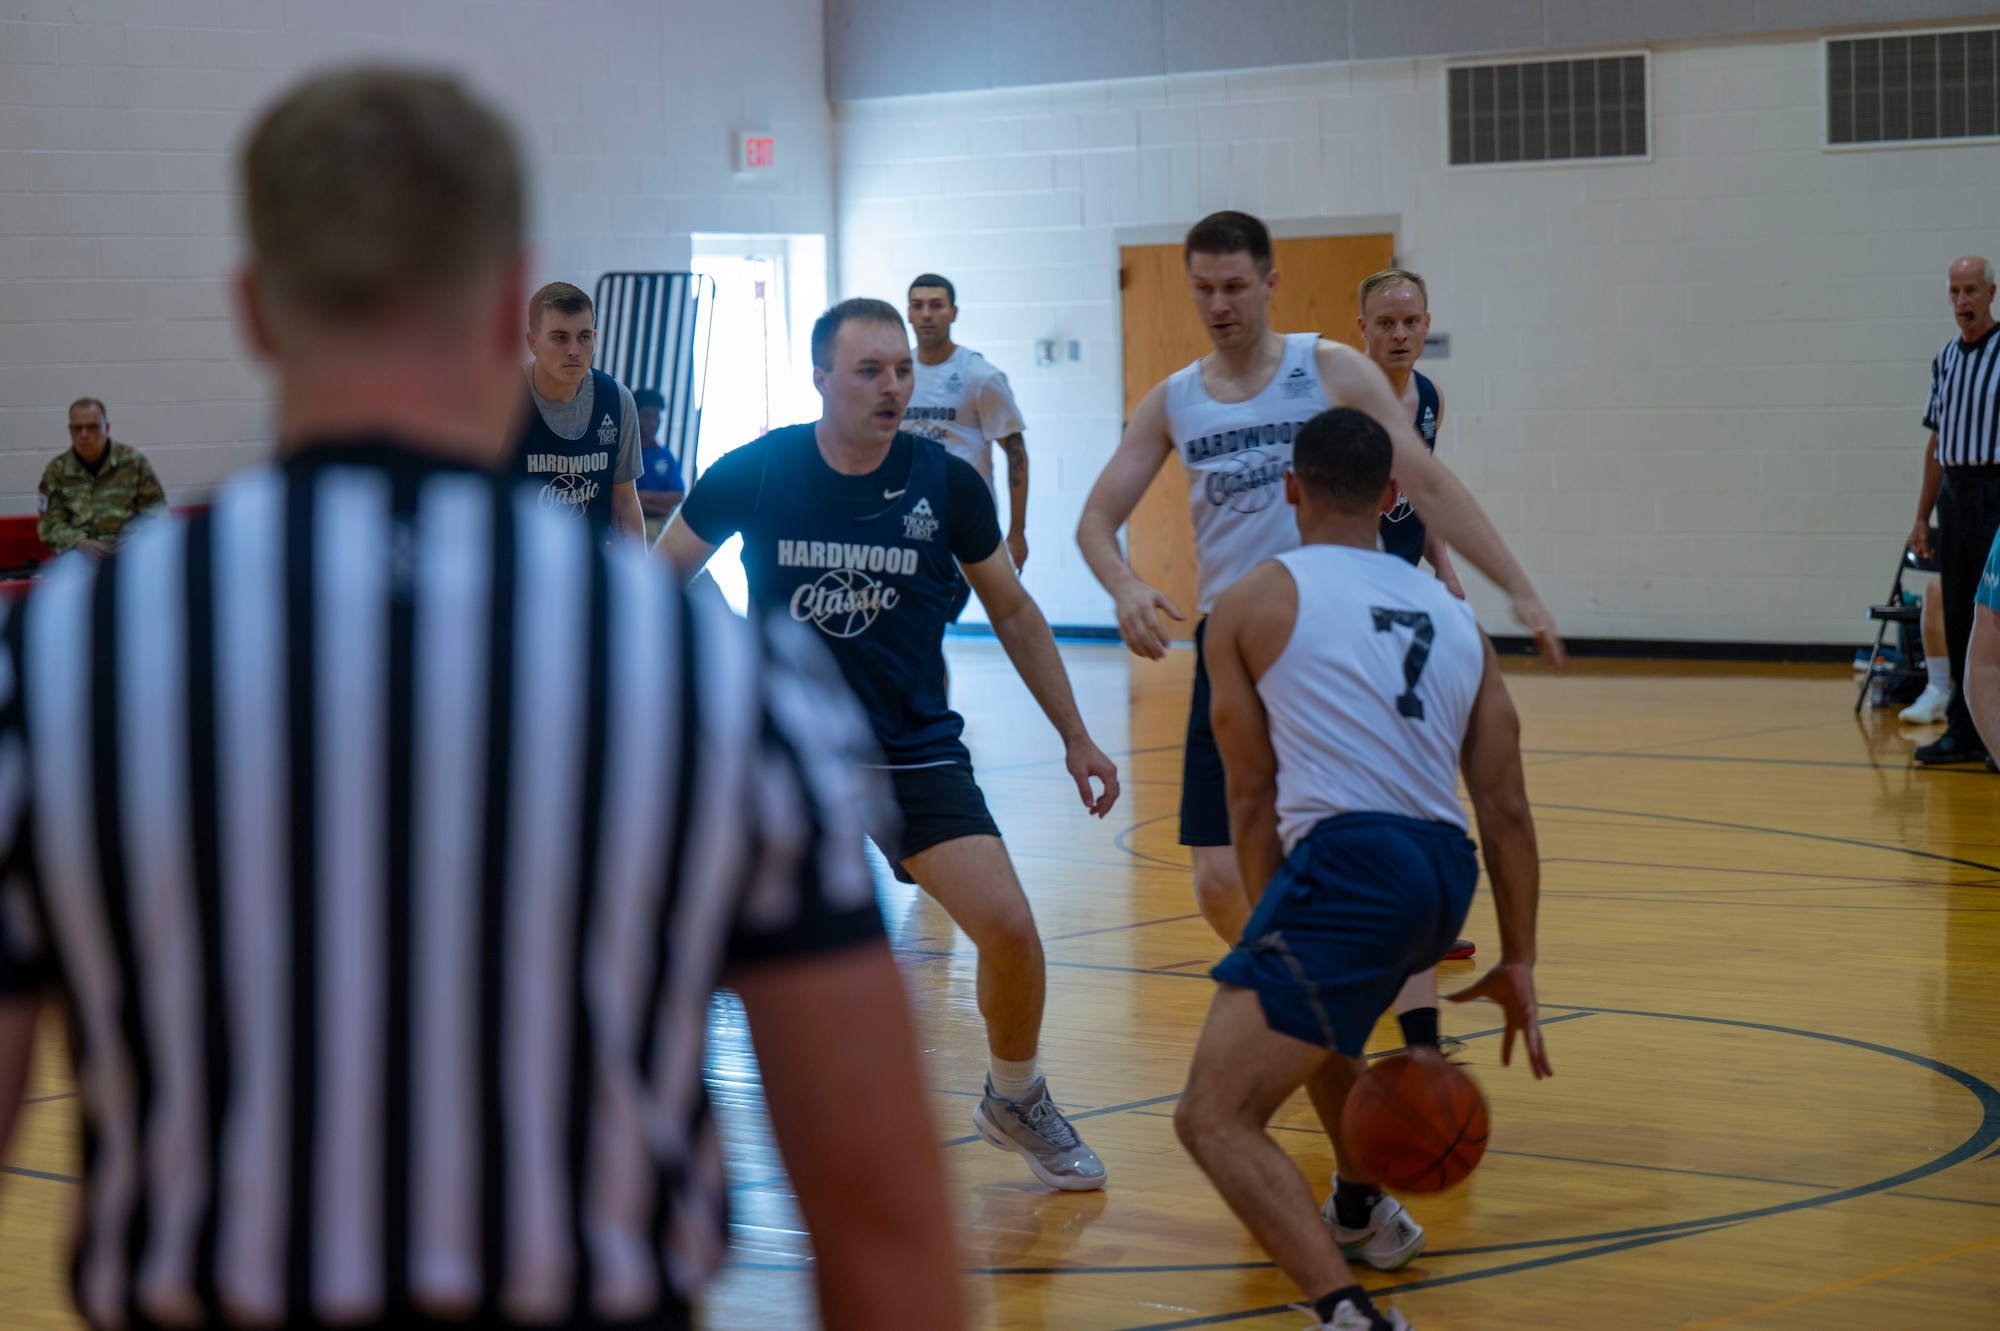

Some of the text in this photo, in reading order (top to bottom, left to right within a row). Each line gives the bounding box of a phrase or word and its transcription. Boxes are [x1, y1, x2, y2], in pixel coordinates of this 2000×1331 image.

[746, 137, 774, 168] EXIT
[527, 452, 608, 474] HARDWOOD
[538, 479, 600, 511] Classic
[902, 514, 940, 530] TROOPS
[905, 525, 932, 539] FIRST
[778, 539, 919, 576] HARDWOOD
[789, 580, 900, 622] Classic
[1369, 605, 1434, 721] 7
